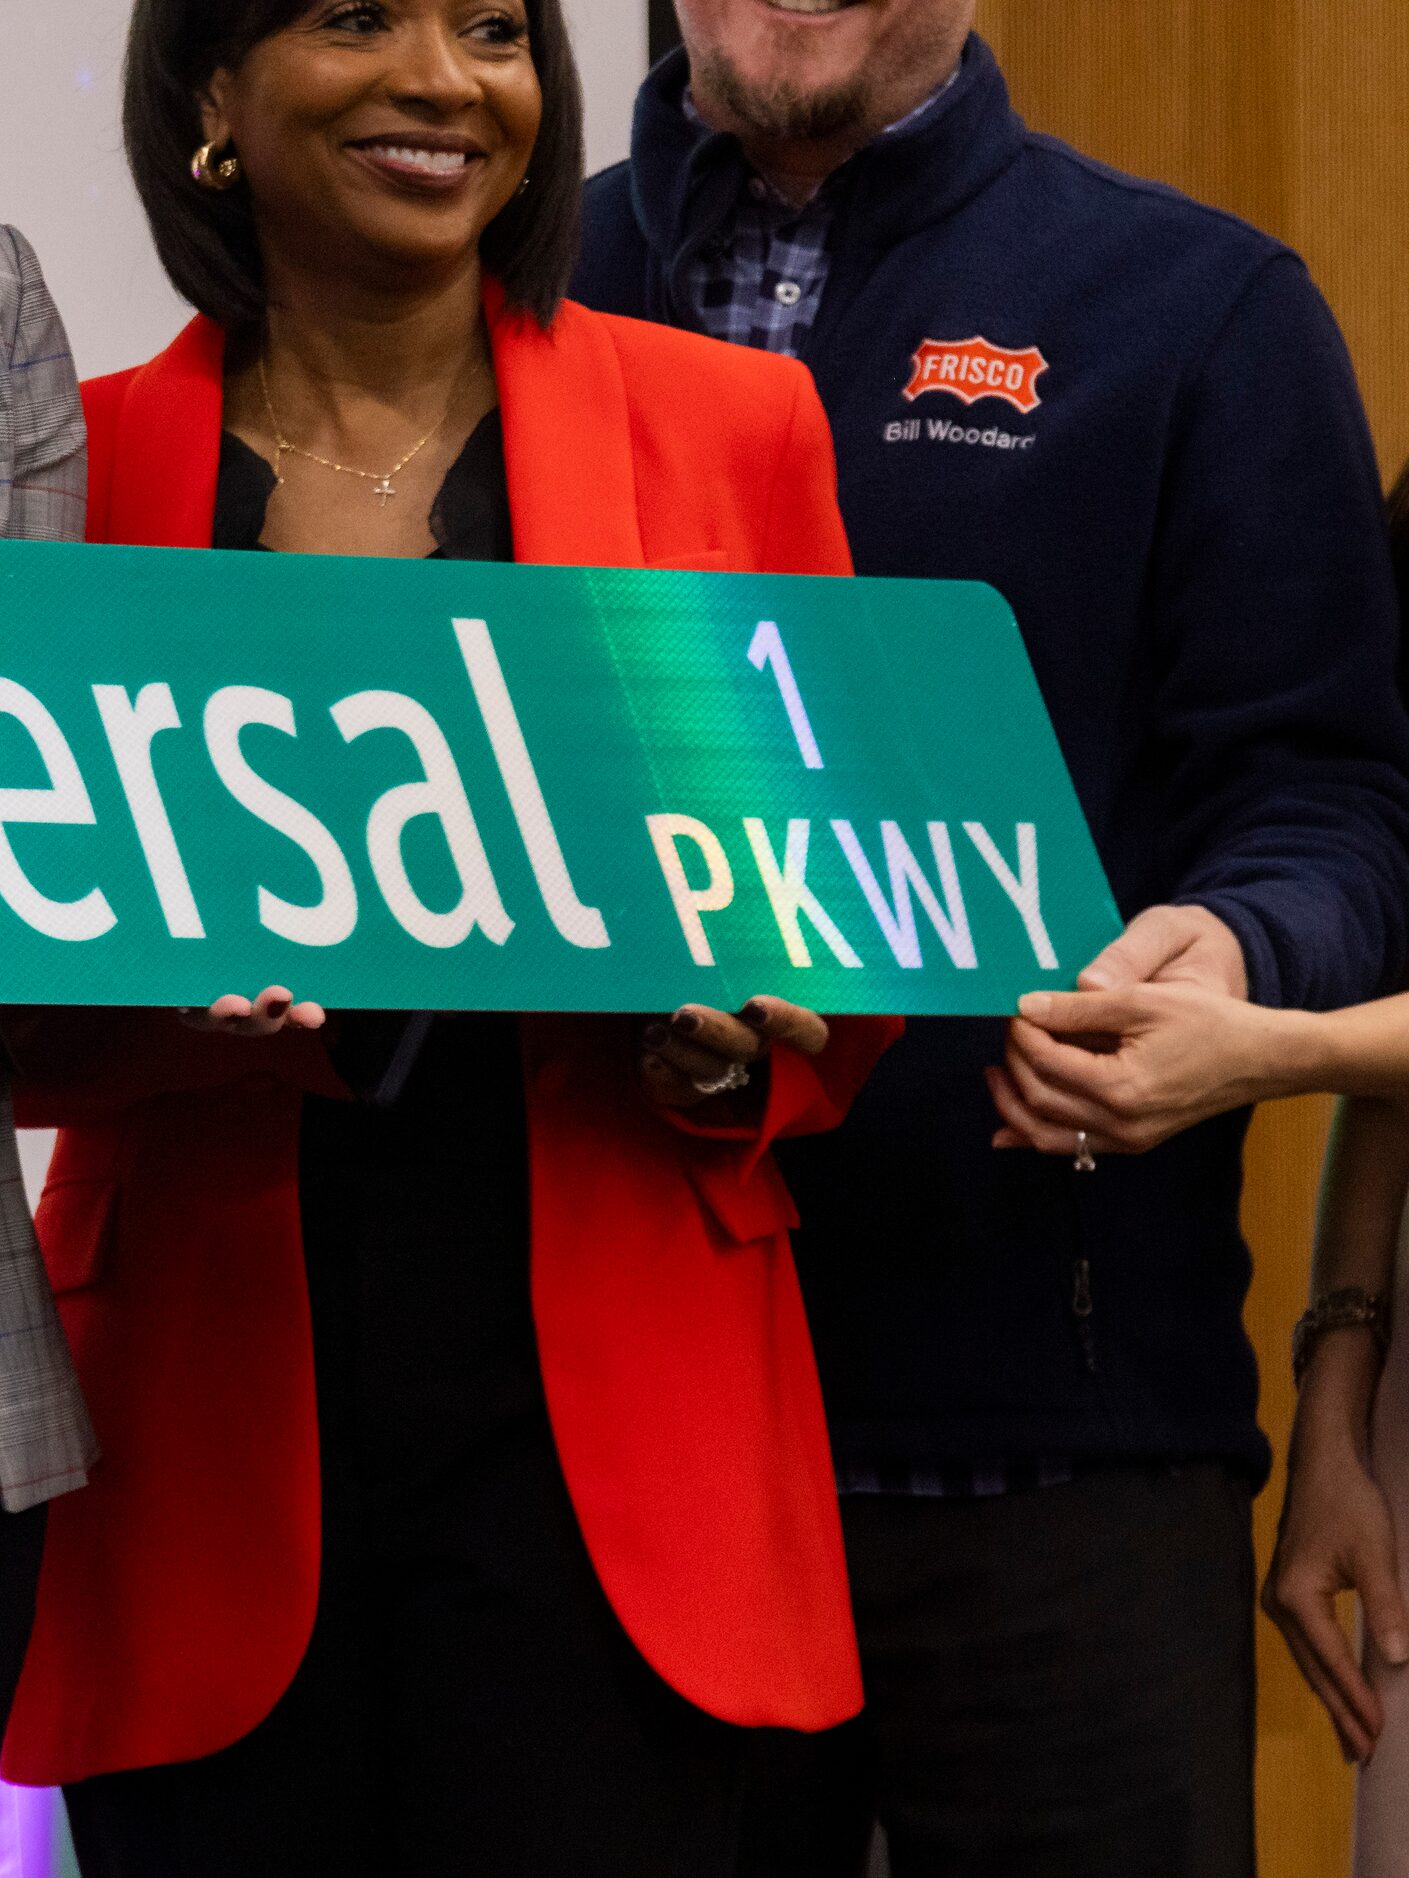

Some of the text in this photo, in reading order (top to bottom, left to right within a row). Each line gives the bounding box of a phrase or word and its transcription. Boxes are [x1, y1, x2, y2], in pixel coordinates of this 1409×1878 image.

[922, 353, 1024, 390] FRISCO
[885, 419, 921, 441] Bill
[746, 620, 825, 770] 1
[644, 812, 1060, 970] PKWY
